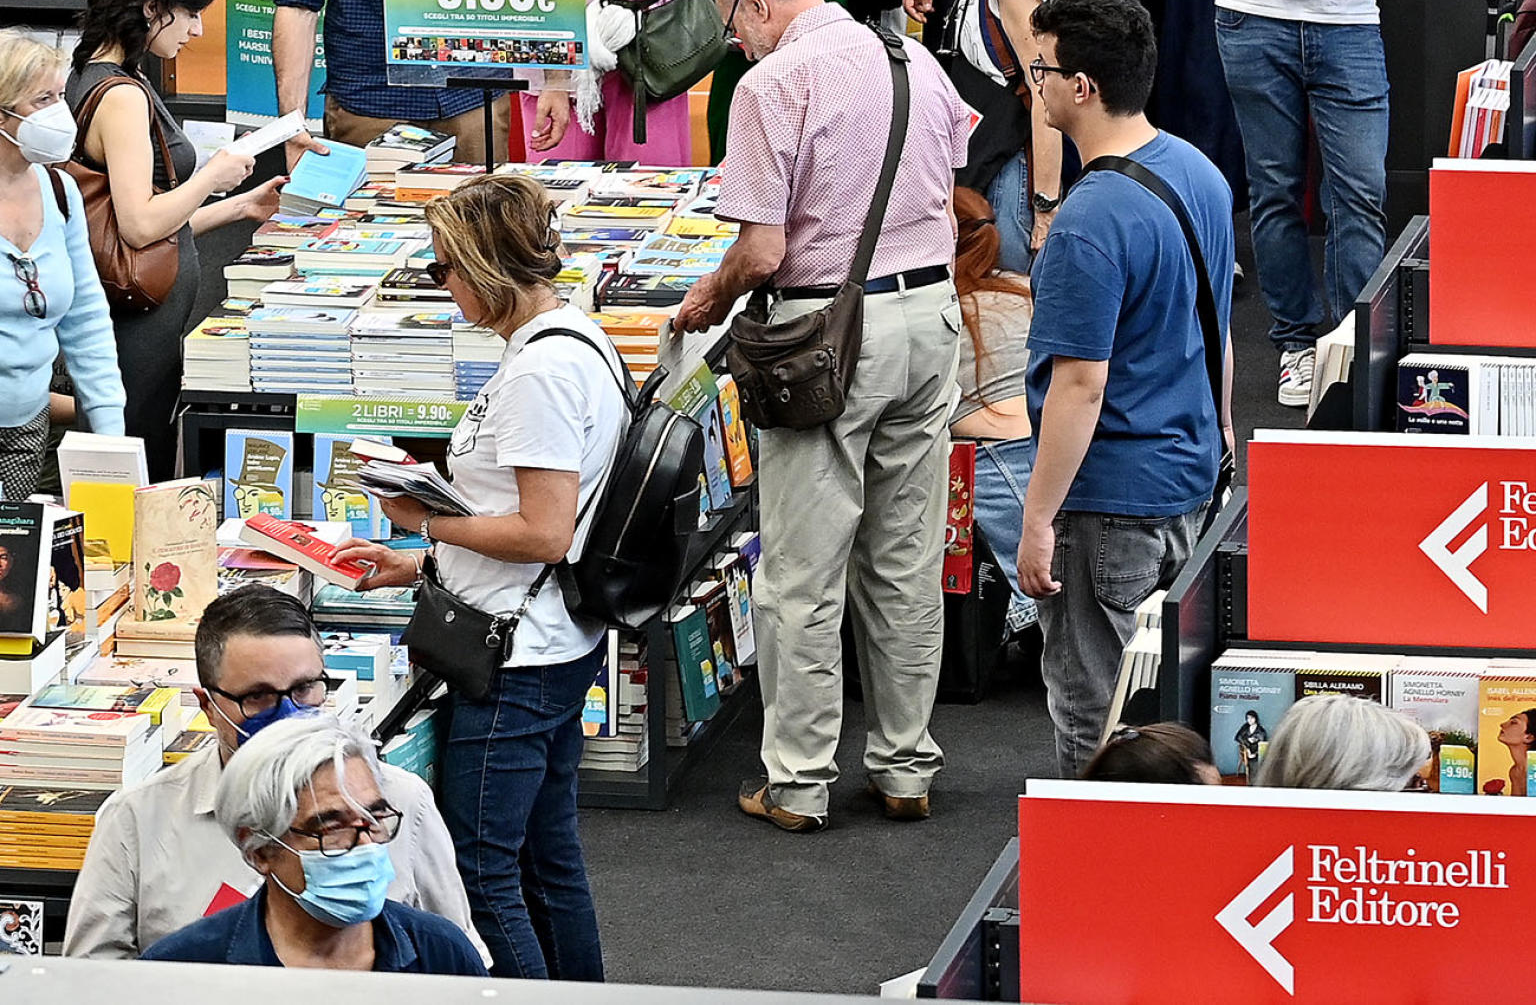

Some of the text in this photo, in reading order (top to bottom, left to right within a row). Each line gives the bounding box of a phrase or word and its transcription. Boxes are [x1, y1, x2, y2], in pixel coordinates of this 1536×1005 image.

[235, 3, 261, 12] SCEGLI
[239, 41, 272, 53] MARSIL
[352, 405, 362, 417] 2
[364, 405, 403, 418] LIBRI
[1219, 678, 1259, 686] SIMONETTA
[1328, 681, 1364, 691] ALERAMO
[1219, 685, 1249, 694] AGNELLO
[1307, 844, 1509, 889] Feltrinelli
[1307, 886, 1460, 928] Editore
